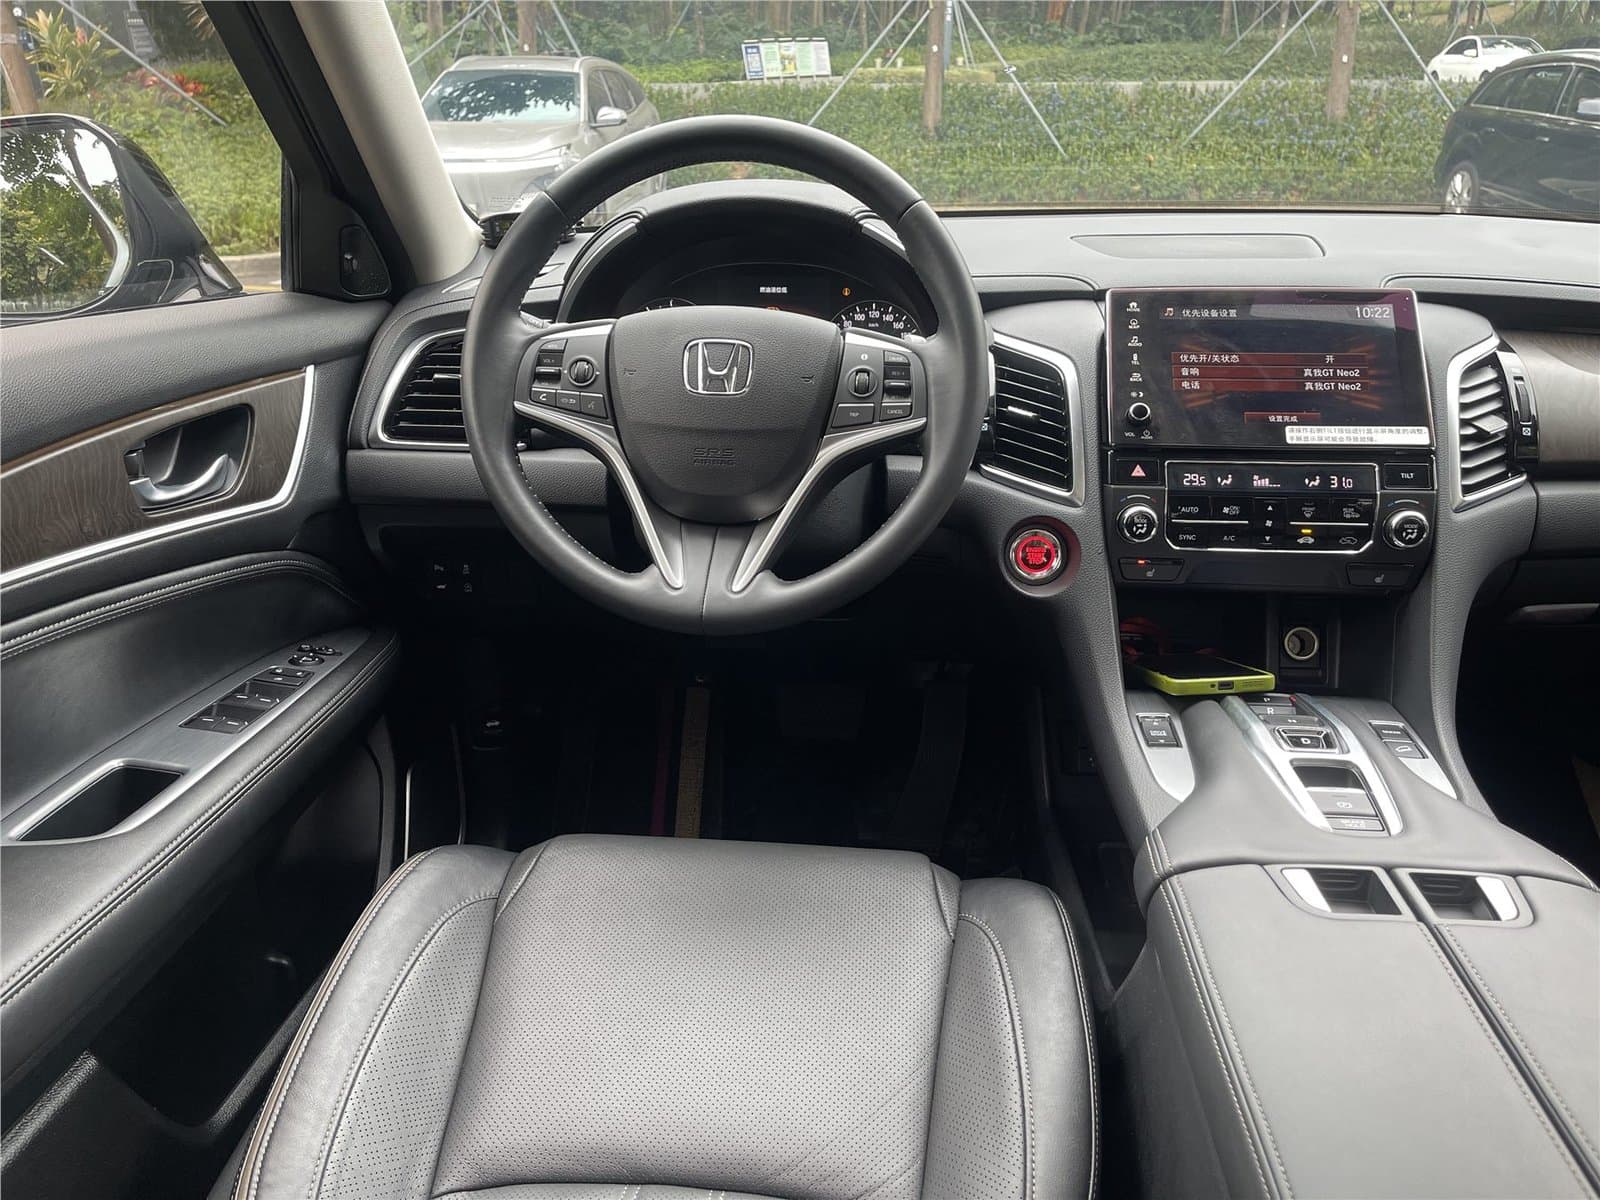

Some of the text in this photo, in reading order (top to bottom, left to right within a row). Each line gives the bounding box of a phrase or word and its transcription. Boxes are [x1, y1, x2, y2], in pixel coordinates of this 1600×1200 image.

[854, 313, 866, 321] 100
[868, 310, 880, 319] 120
[1181, 308, 1238, 318] 优先设备设置
[1355, 306, 1391, 319] 10:22
[882, 313, 894, 322] 140
[842, 320, 853, 328] 80
[892, 321, 905, 330] 160
[1179, 354, 1240, 363] 优先开/关状态
[1325, 355, 1335, 364] 开
[1180, 367, 1200, 376] 音响
[1336, 368, 1360, 378] Neo2
[1181, 380, 1201, 390] 电话
[1337, 382, 1362, 391] Neo2
[693, 447, 736, 458] SRS
[1183, 473, 1207, 487] 29.5
[1400, 472, 1415, 480] TILT
[1267, 707, 1275, 715] R
[1301, 737, 1312, 745] D
